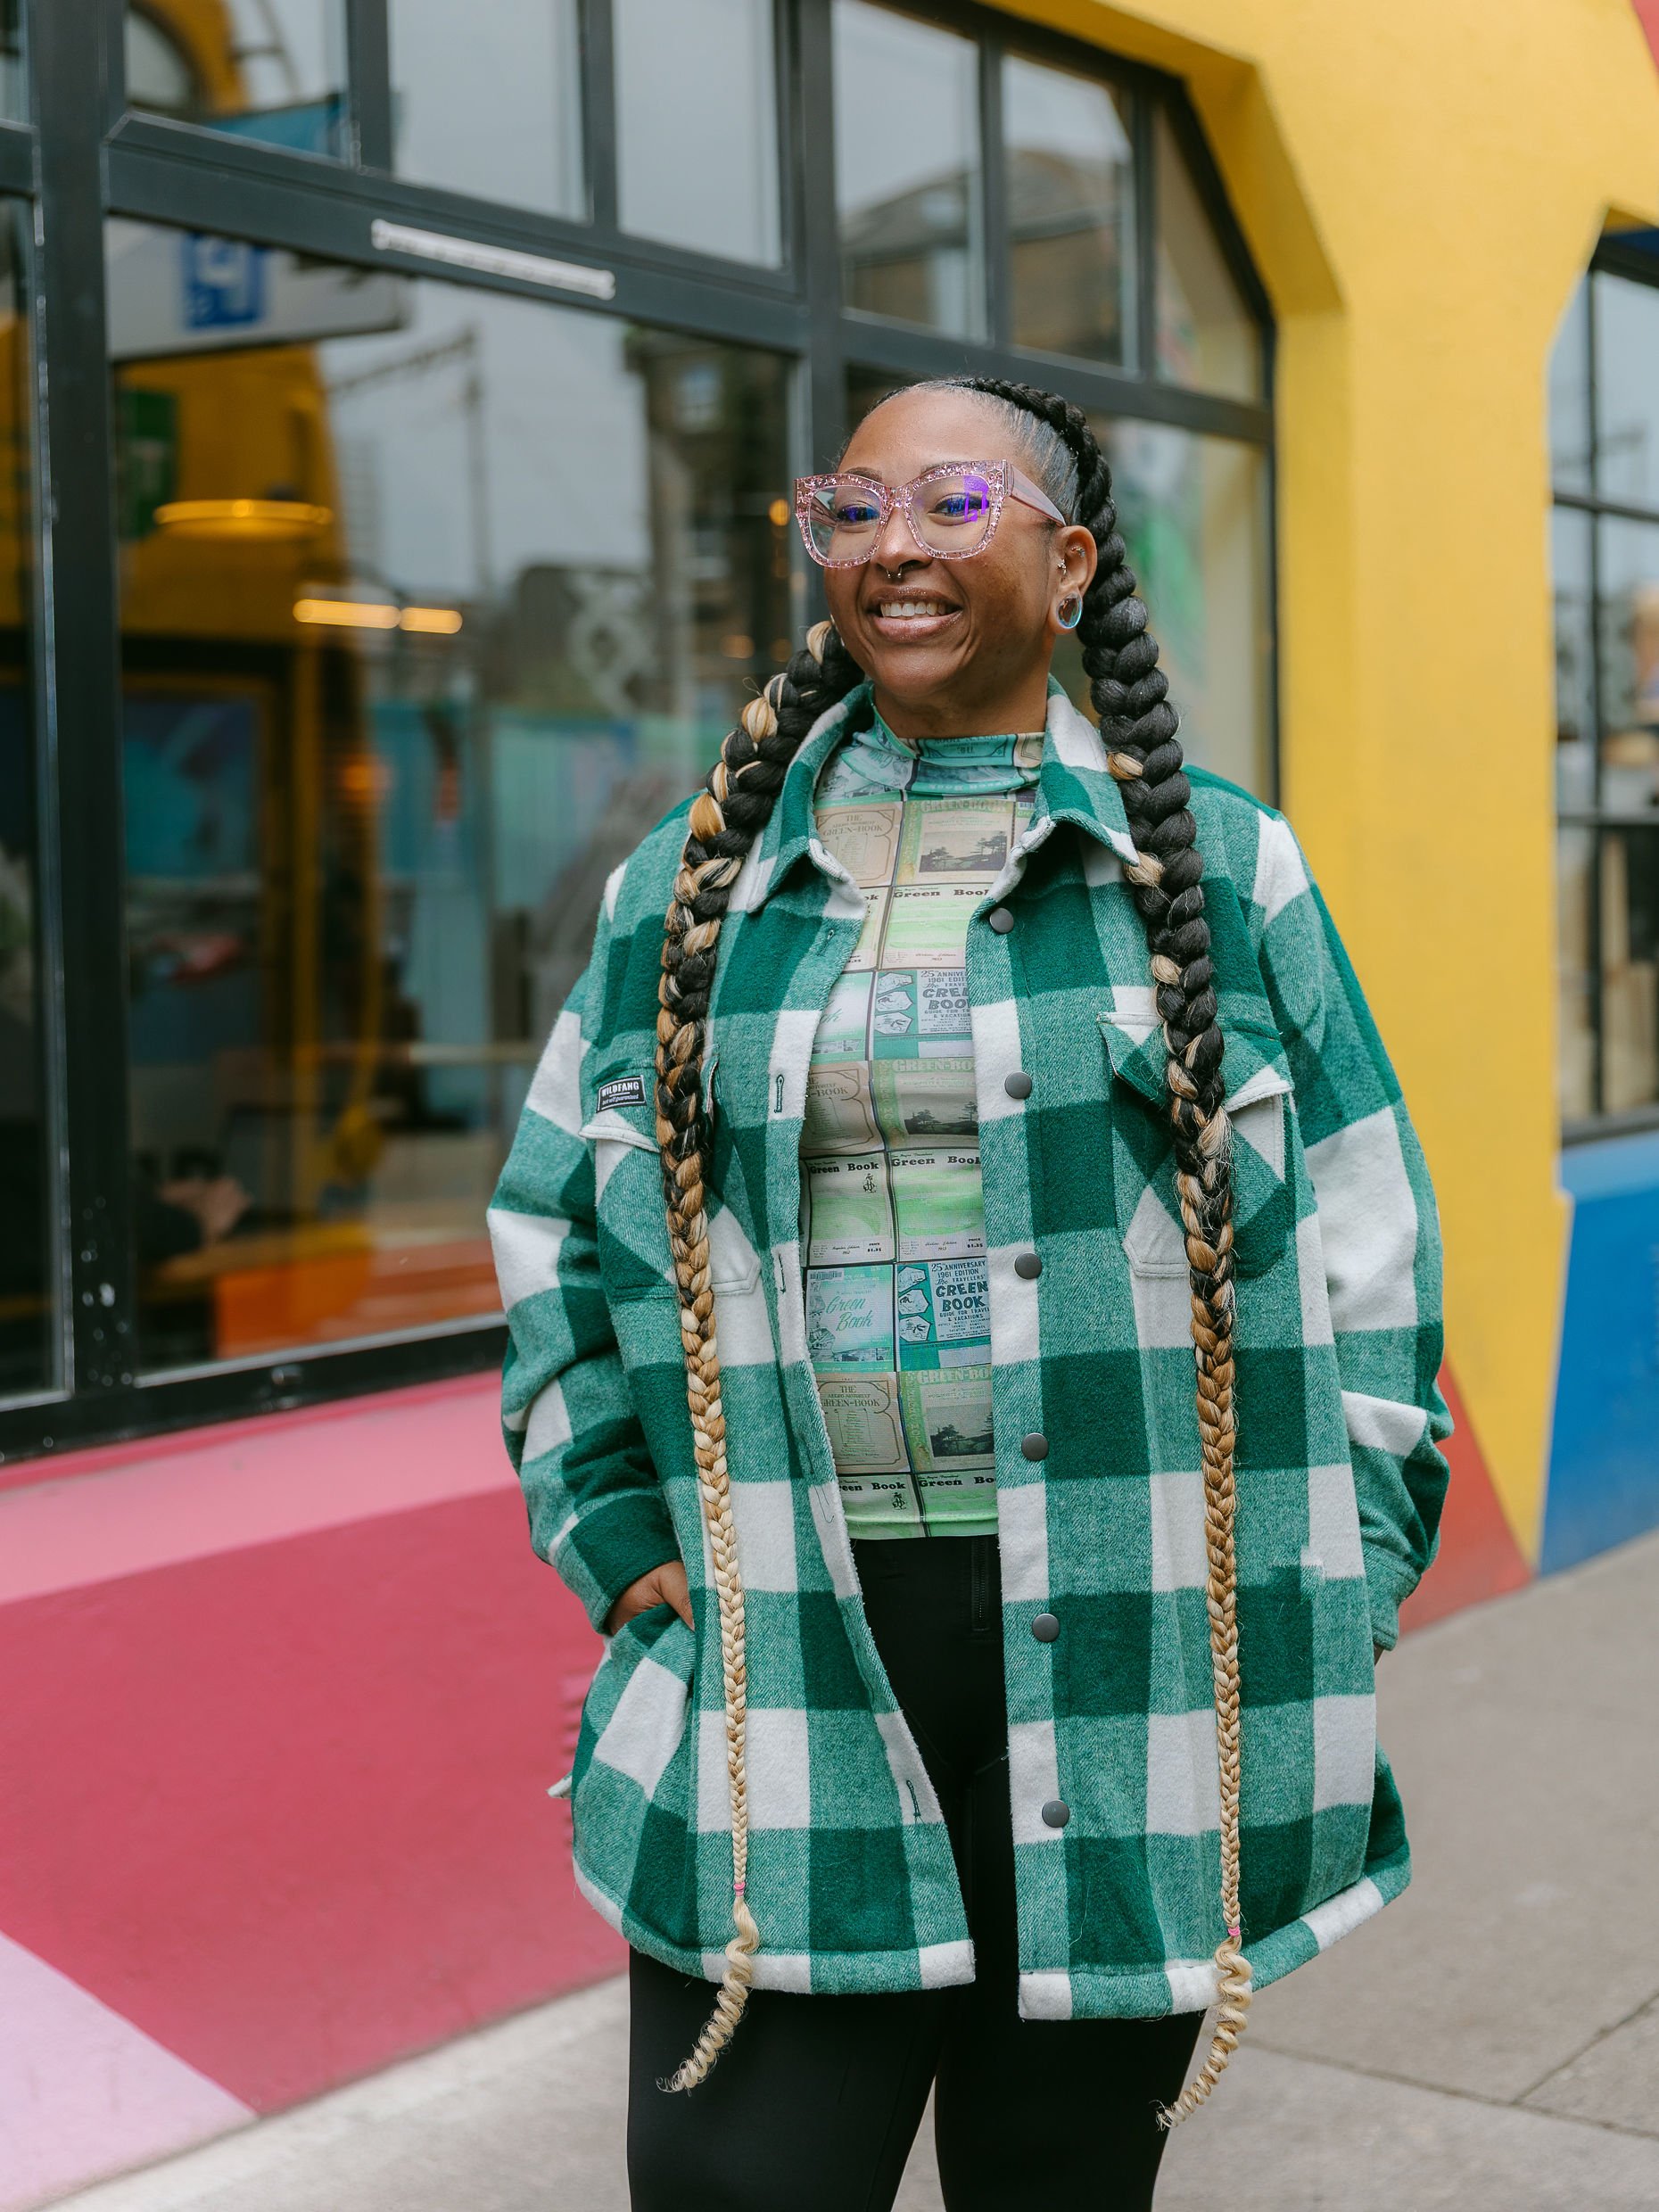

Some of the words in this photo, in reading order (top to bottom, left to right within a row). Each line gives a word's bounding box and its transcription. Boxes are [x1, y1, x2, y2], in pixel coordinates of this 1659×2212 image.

[893, 890, 941, 898] Green
[929, 999, 969, 1011] BOO
[601, 1081, 640, 1097] WILDFANG
[810, 1165, 840, 1174] Green
[847, 1161, 879, 1172] Book
[892, 1158, 936, 1167] Green
[945, 1260, 986, 1271] ANNIVERSARY
[937, 1271, 952, 1279] 1961
[954, 1267, 979, 1277] EDITION
[936, 1281, 989, 1298] GREEN
[826, 1295, 866, 1315] Green
[942, 1295, 986, 1312] BOOK
[835, 1309, 873, 1332] Book
[954, 1313, 984, 1322] VACATIONS
[839, 1384, 856, 1393] THE
[871, 1482, 907, 1490] Book
[919, 1479, 963, 1488] Green
